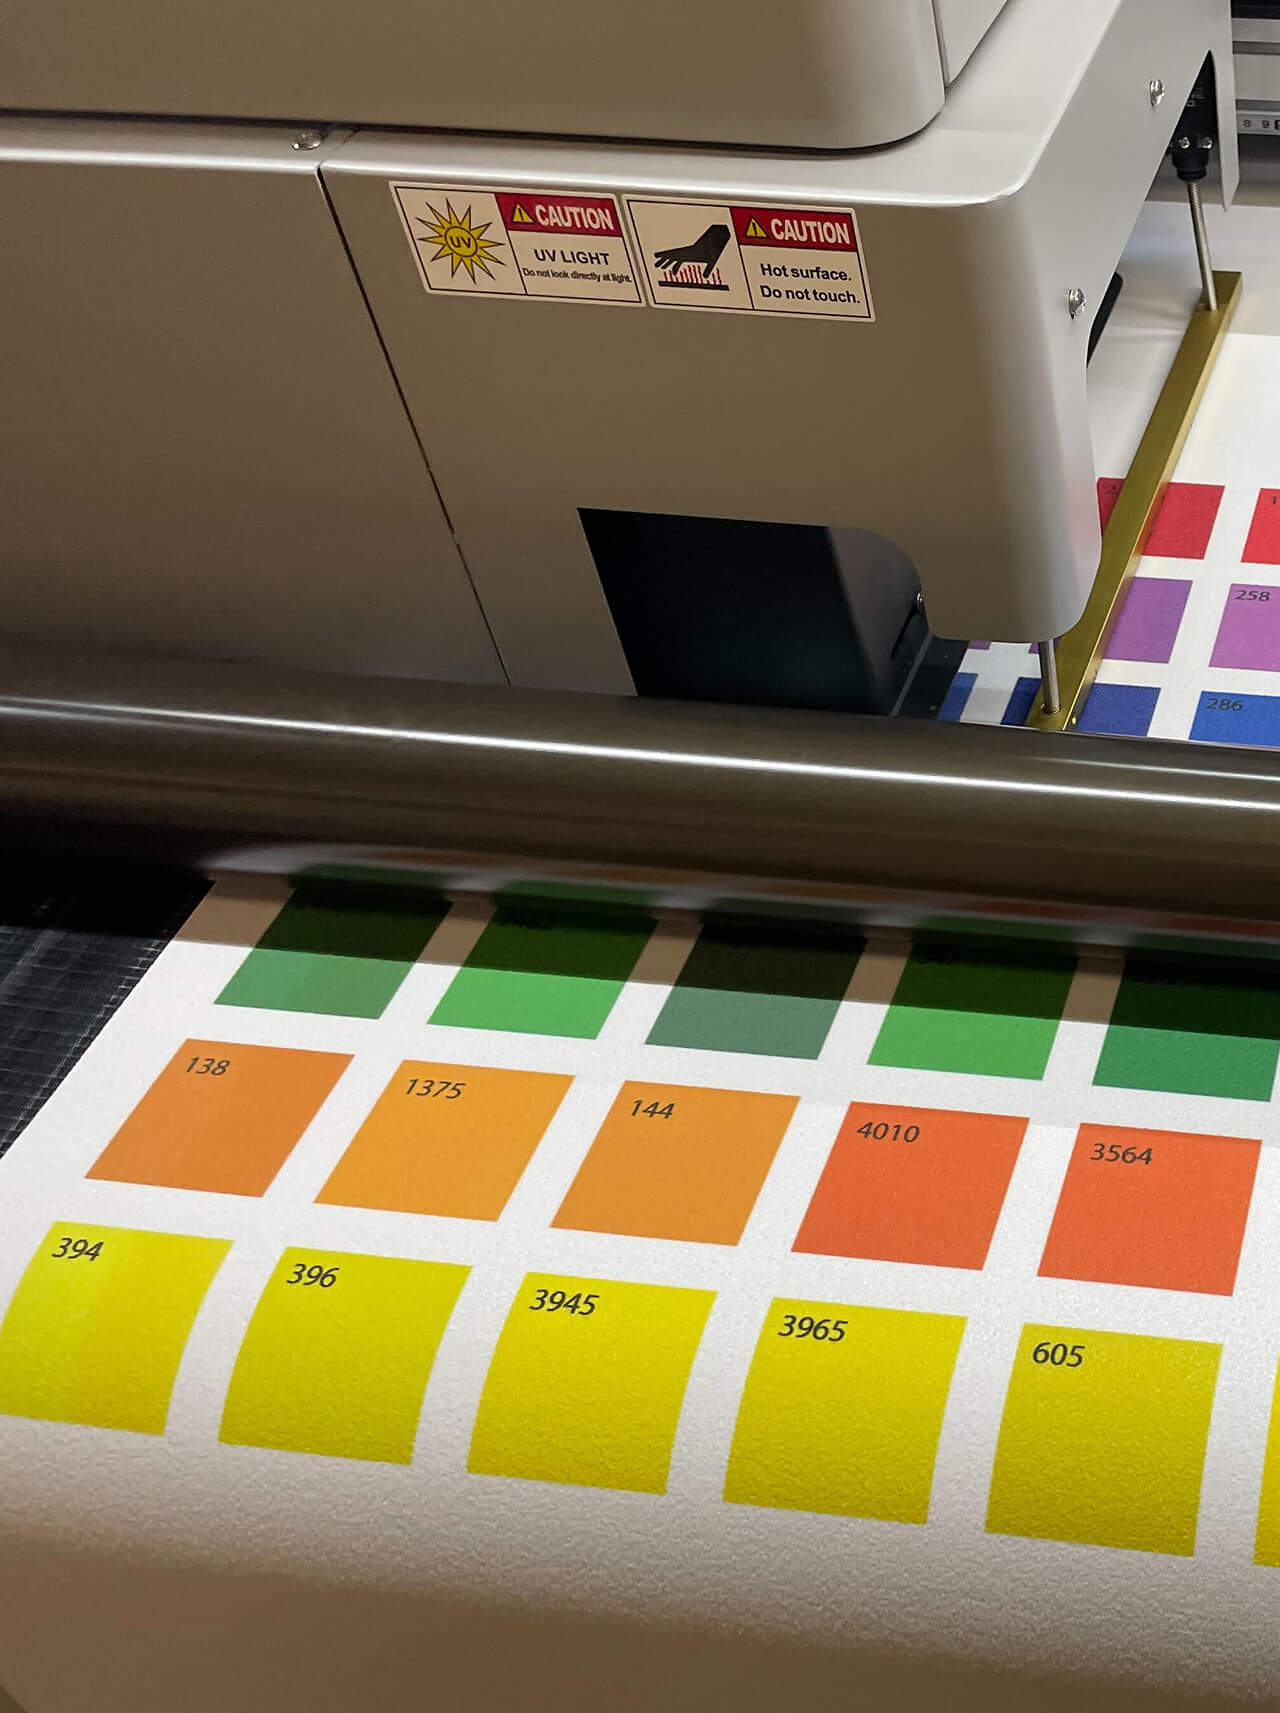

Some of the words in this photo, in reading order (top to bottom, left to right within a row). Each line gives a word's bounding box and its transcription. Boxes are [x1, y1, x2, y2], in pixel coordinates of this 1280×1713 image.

[536, 204, 614, 230] CAUTION
[450, 236, 471, 248] UV
[770, 218, 850, 244] CAUTION
[534, 249, 556, 262] UV
[560, 250, 610, 265] LIGHT
[522, 267, 536, 277] Do
[536, 270, 550, 278] not
[551, 269, 570, 279] look
[571, 270, 600, 282] directly
[602, 273, 610, 282] at
[611, 273, 632, 284] light.
[760, 263, 789, 277] Hot
[791, 266, 852, 281] surface.
[760, 285, 782, 298] Do
[785, 288, 811, 301] not
[812, 289, 861, 304] touch.
[1234, 589, 1271, 602] 258
[1205, 698, 1243, 711] 286
[186, 1056, 231, 1076] 138
[406, 1078, 466, 1100] 1375
[631, 1099, 675, 1119] 144
[856, 1121, 920, 1143] 4010
[1089, 1143, 1153, 1165] 3564
[51, 1237, 104, 1262] 394
[286, 1263, 340, 1288] 396
[529, 1289, 600, 1316] 3945
[777, 1314, 849, 1342] 3965
[1032, 1341, 1086, 1368] 605
